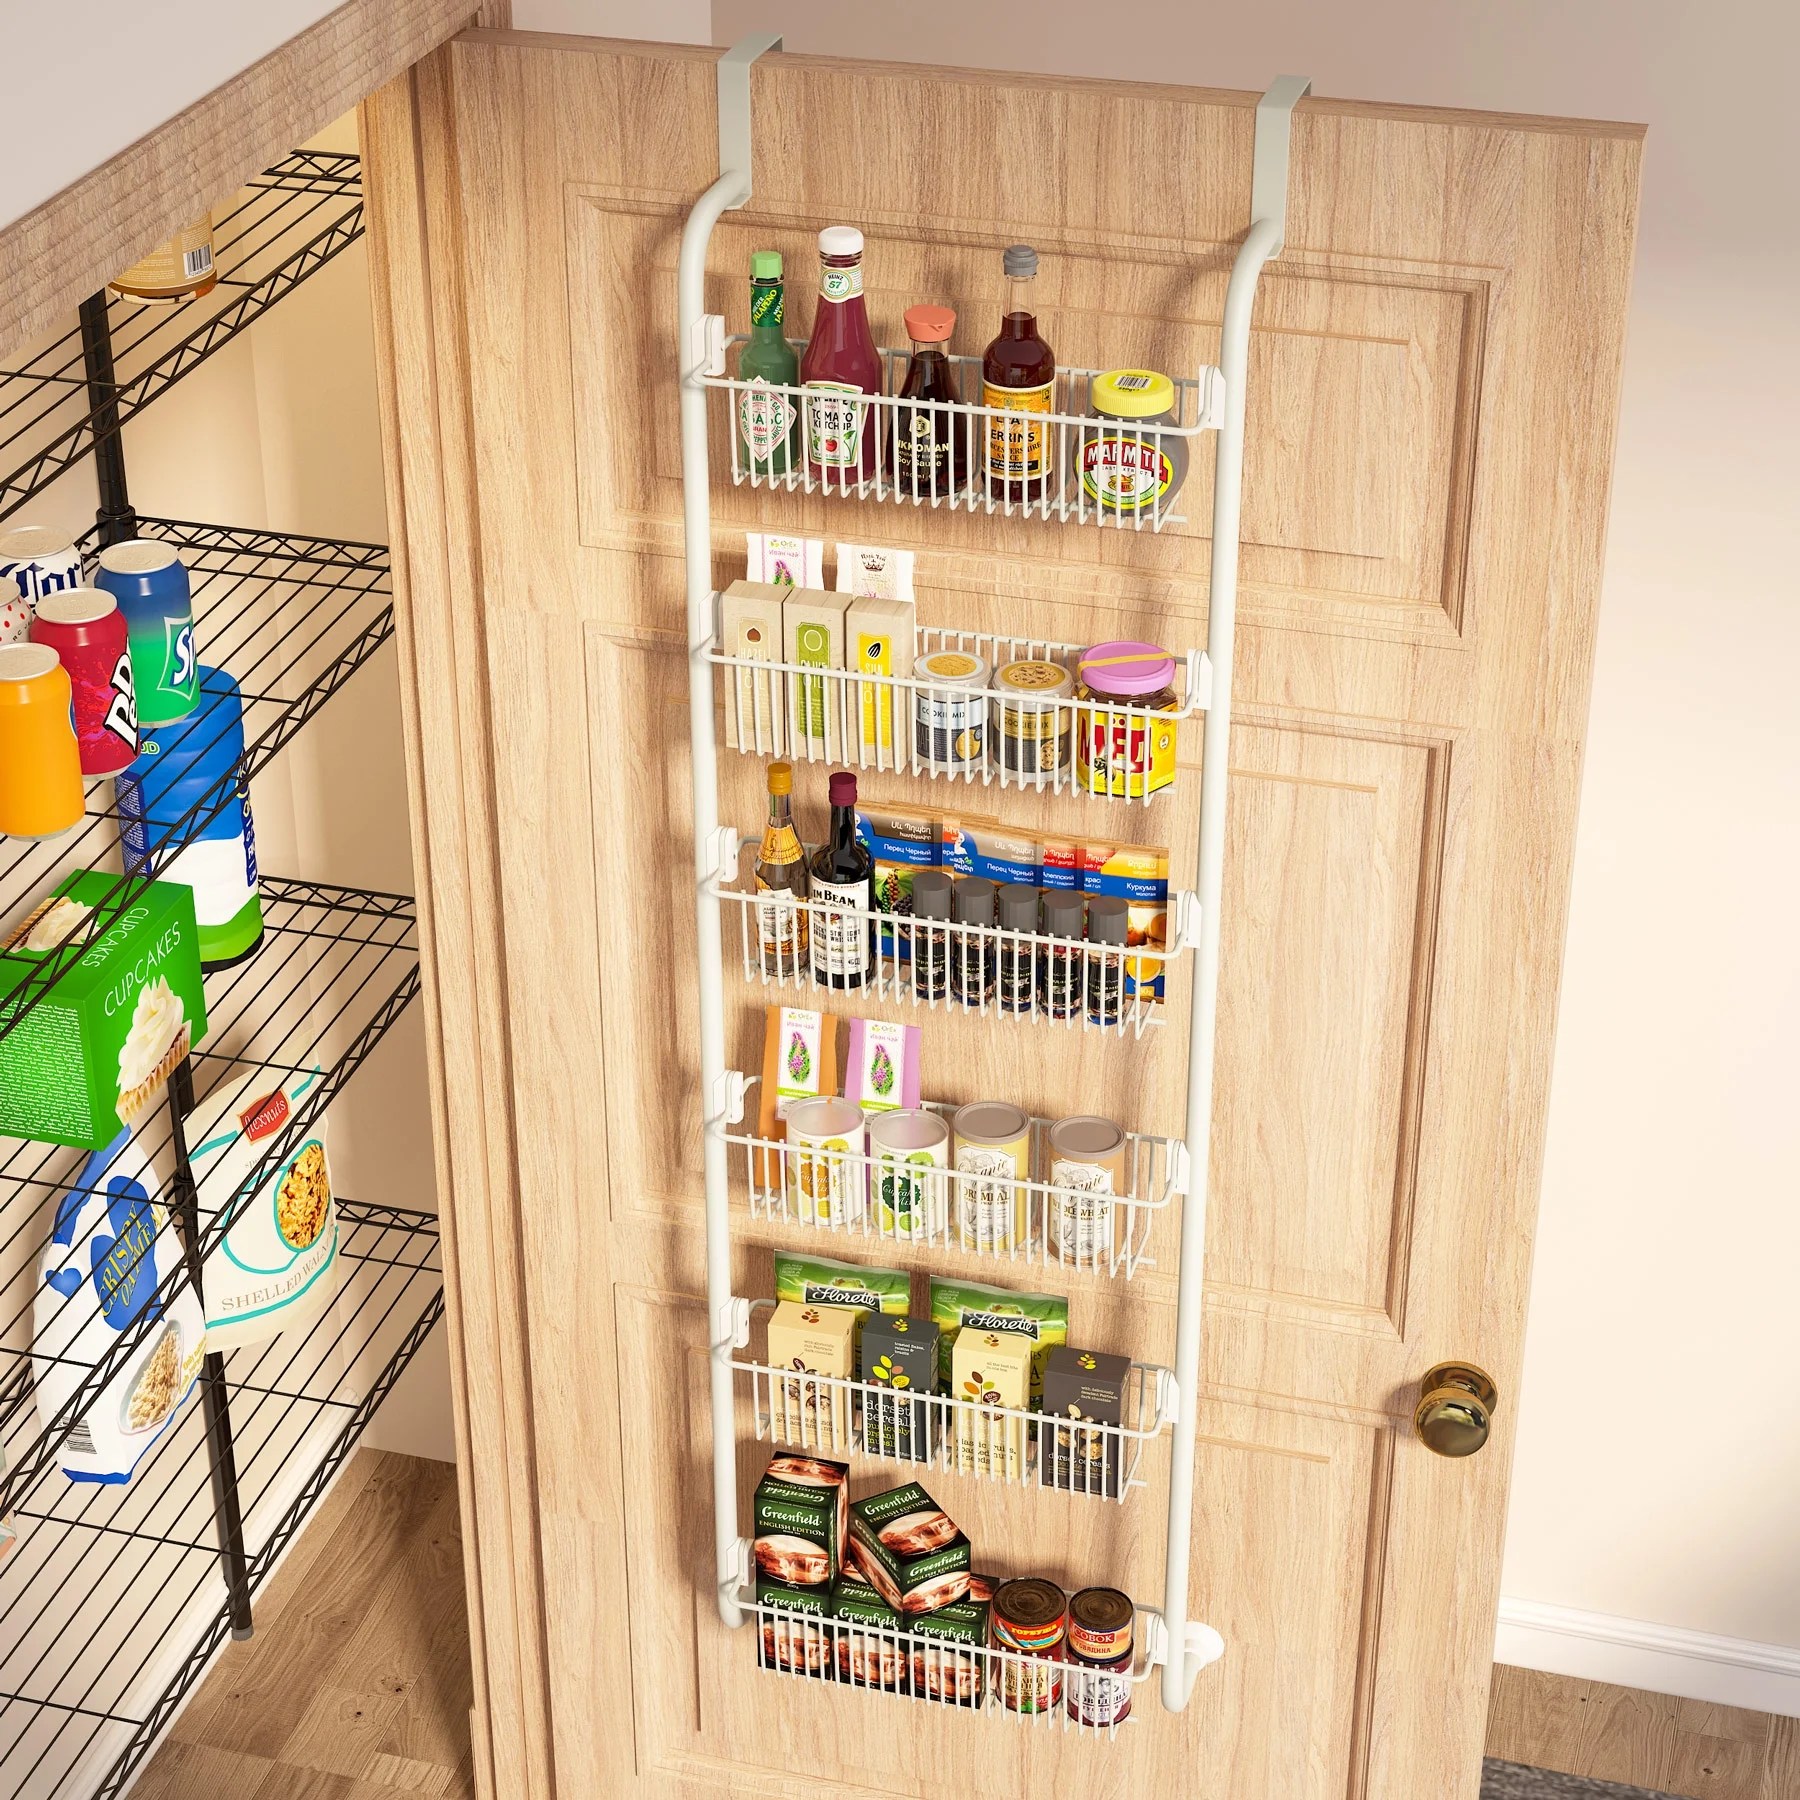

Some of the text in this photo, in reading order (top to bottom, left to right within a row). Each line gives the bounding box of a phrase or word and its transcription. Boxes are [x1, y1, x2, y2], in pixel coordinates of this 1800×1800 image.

[828, 280, 842, 289] 57
[990, 429, 1035, 443] ERRINS
[916, 459, 942, 467] Saue
[883, 844, 932, 856] Перец Черный
[986, 862, 1035, 877] Перец Черный
[1126, 882, 1157, 892] Куркума
[824, 889, 856, 909] BEAM
[81, 907, 149, 968] CUPCAKES
[104, 921, 181, 1017] CUPCAKES
[1080, 1207, 1109, 1217] WHAT
[221, 1271, 302, 1312] SHELLED
[812, 1286, 877, 1307] Florette
[968, 1312, 1035, 1334] Florette
[765, 1485, 825, 1503] Greenfield
[866, 1489, 919, 1516] Greenfield
[899, 1498, 930, 1514] EDITION
[761, 1505, 820, 1527] Greenfield
[759, 1520, 825, 1537] ENGLISH EDITION
[909, 1550, 965, 1577] Greenfield
[936, 1559, 968, 1574] EDITION
[763, 1592, 822, 1613] Greenfield
[842, 1587, 881, 1599] enfield
[838, 1607, 897, 1627] Greenfield
[913, 1621, 973, 1642] Greenfield
